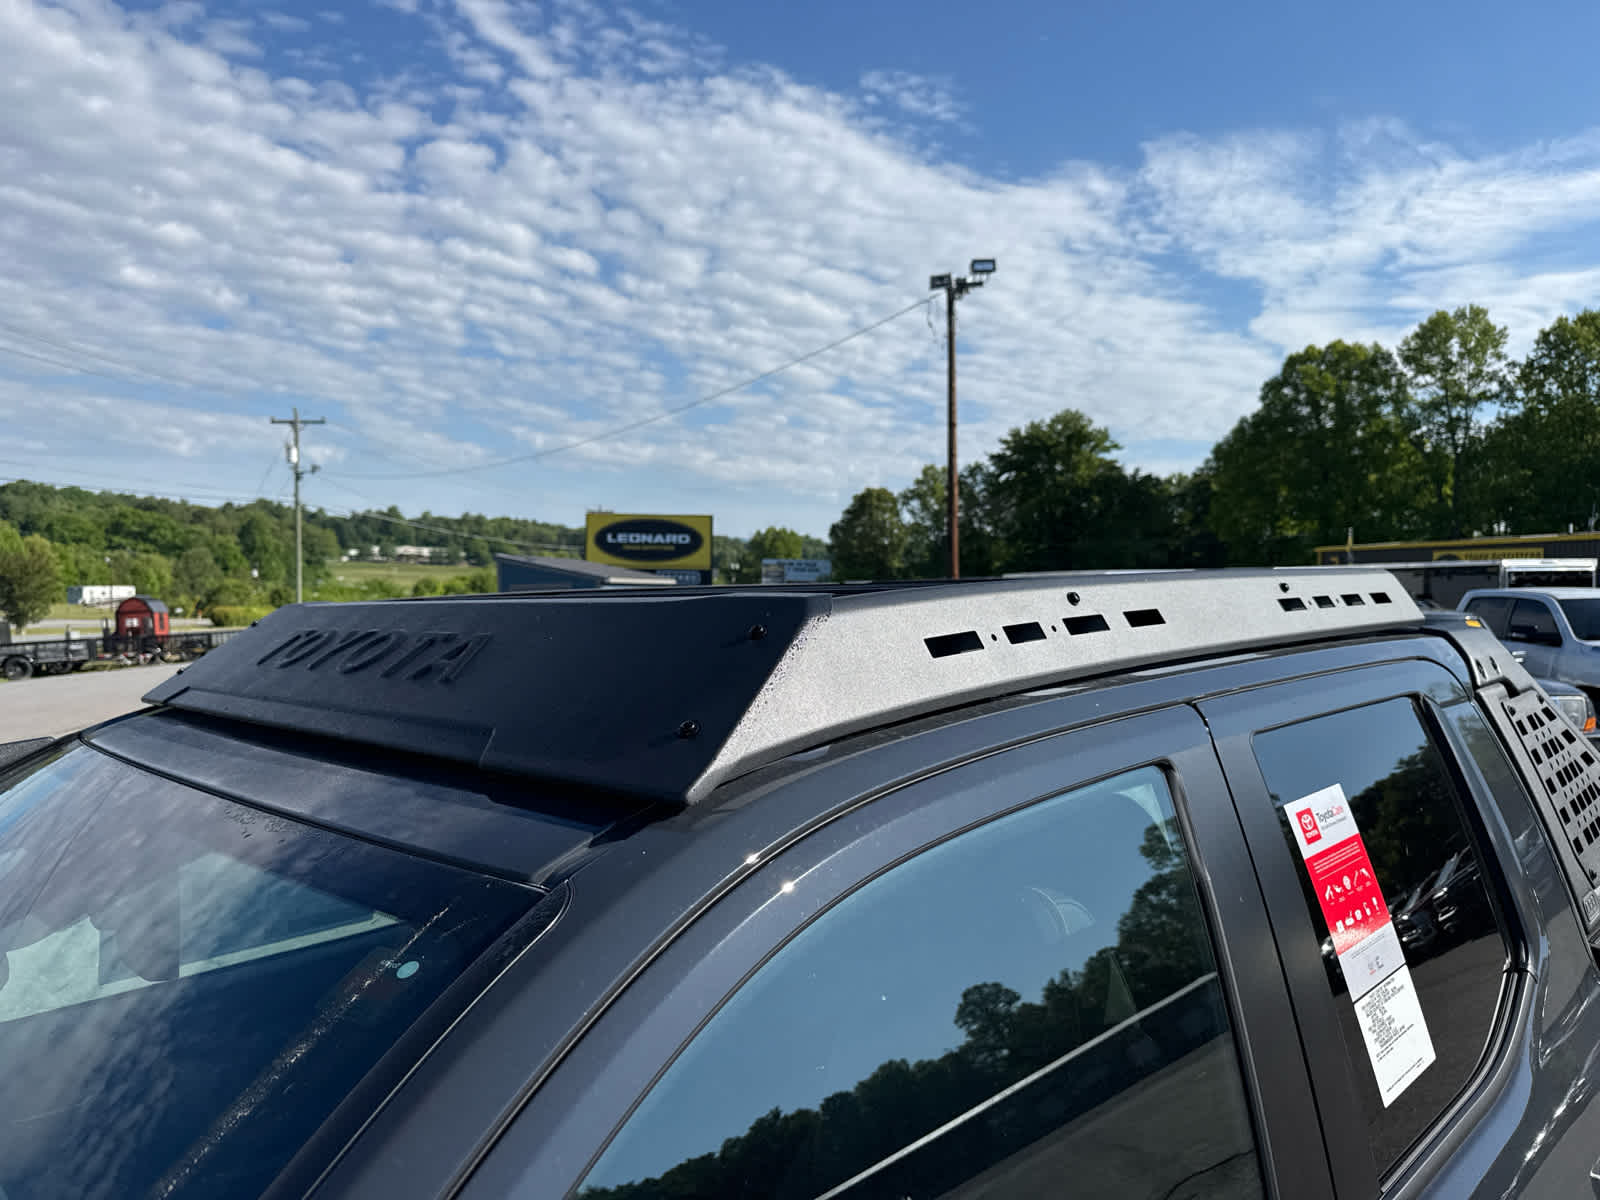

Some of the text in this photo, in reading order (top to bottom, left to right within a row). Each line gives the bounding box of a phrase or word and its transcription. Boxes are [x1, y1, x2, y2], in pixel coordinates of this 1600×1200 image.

[606, 532, 691, 545] LEONARD
[256, 629, 494, 683] TOYOTA
[1315, 805, 1344, 823] ToyotaC
